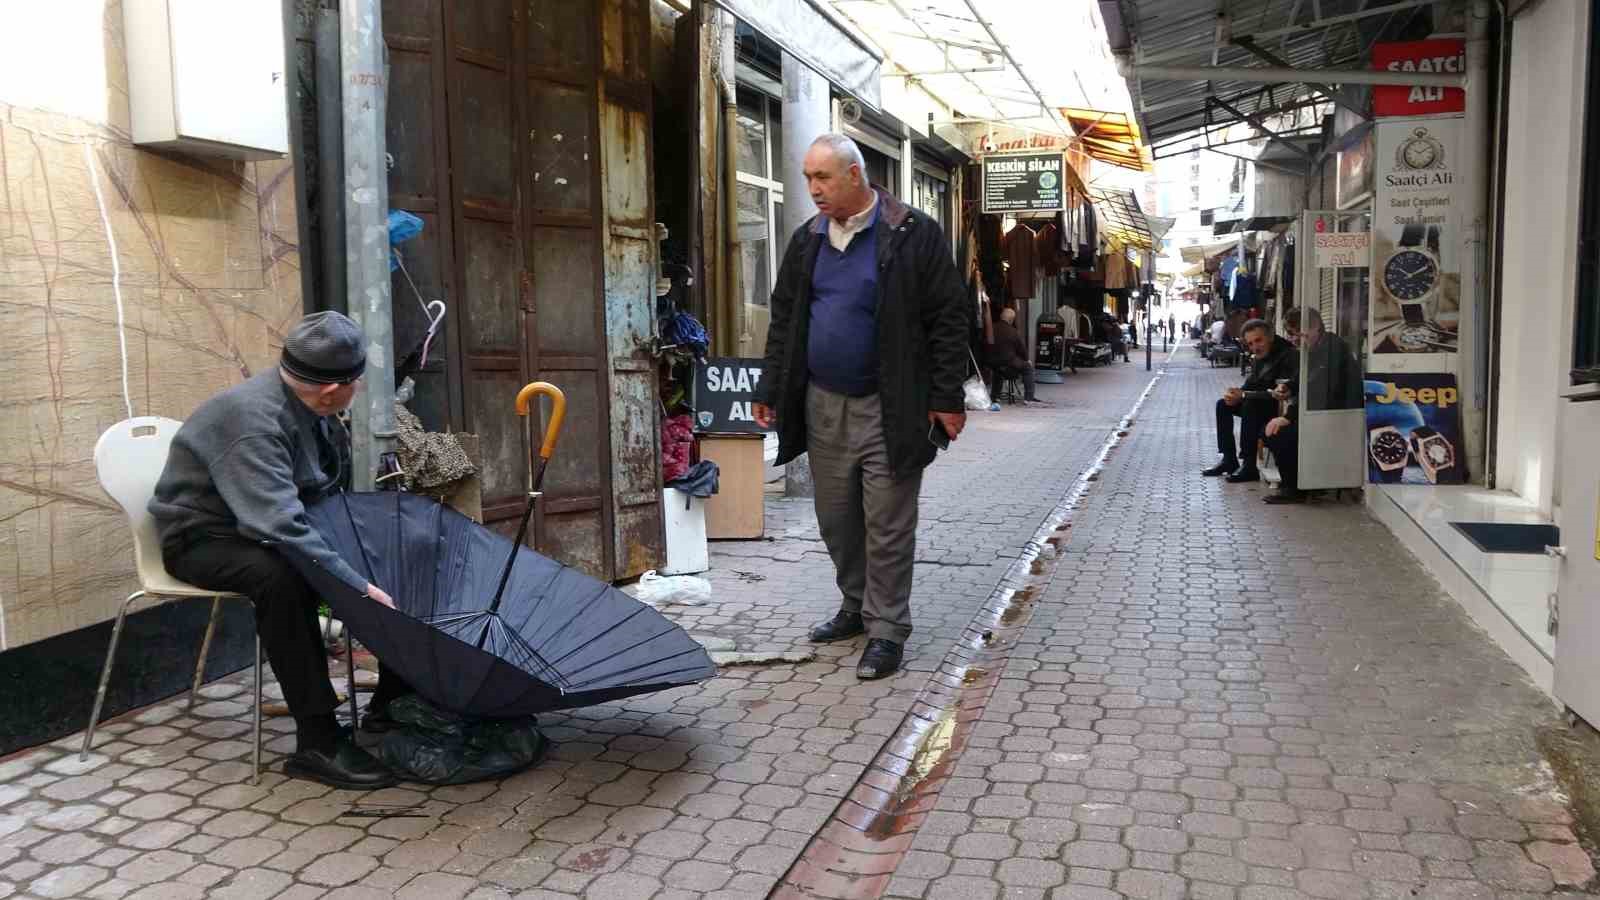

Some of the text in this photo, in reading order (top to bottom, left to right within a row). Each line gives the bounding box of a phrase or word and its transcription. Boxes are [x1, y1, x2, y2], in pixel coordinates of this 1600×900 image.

[987, 157, 1060, 172] KESKİN SİLAH
[1385, 172, 1453, 187] Saatçi Ali
[706, 366, 763, 392] SAAT
[1376, 383, 1457, 408] Jeep
[728, 401, 755, 422] AL
